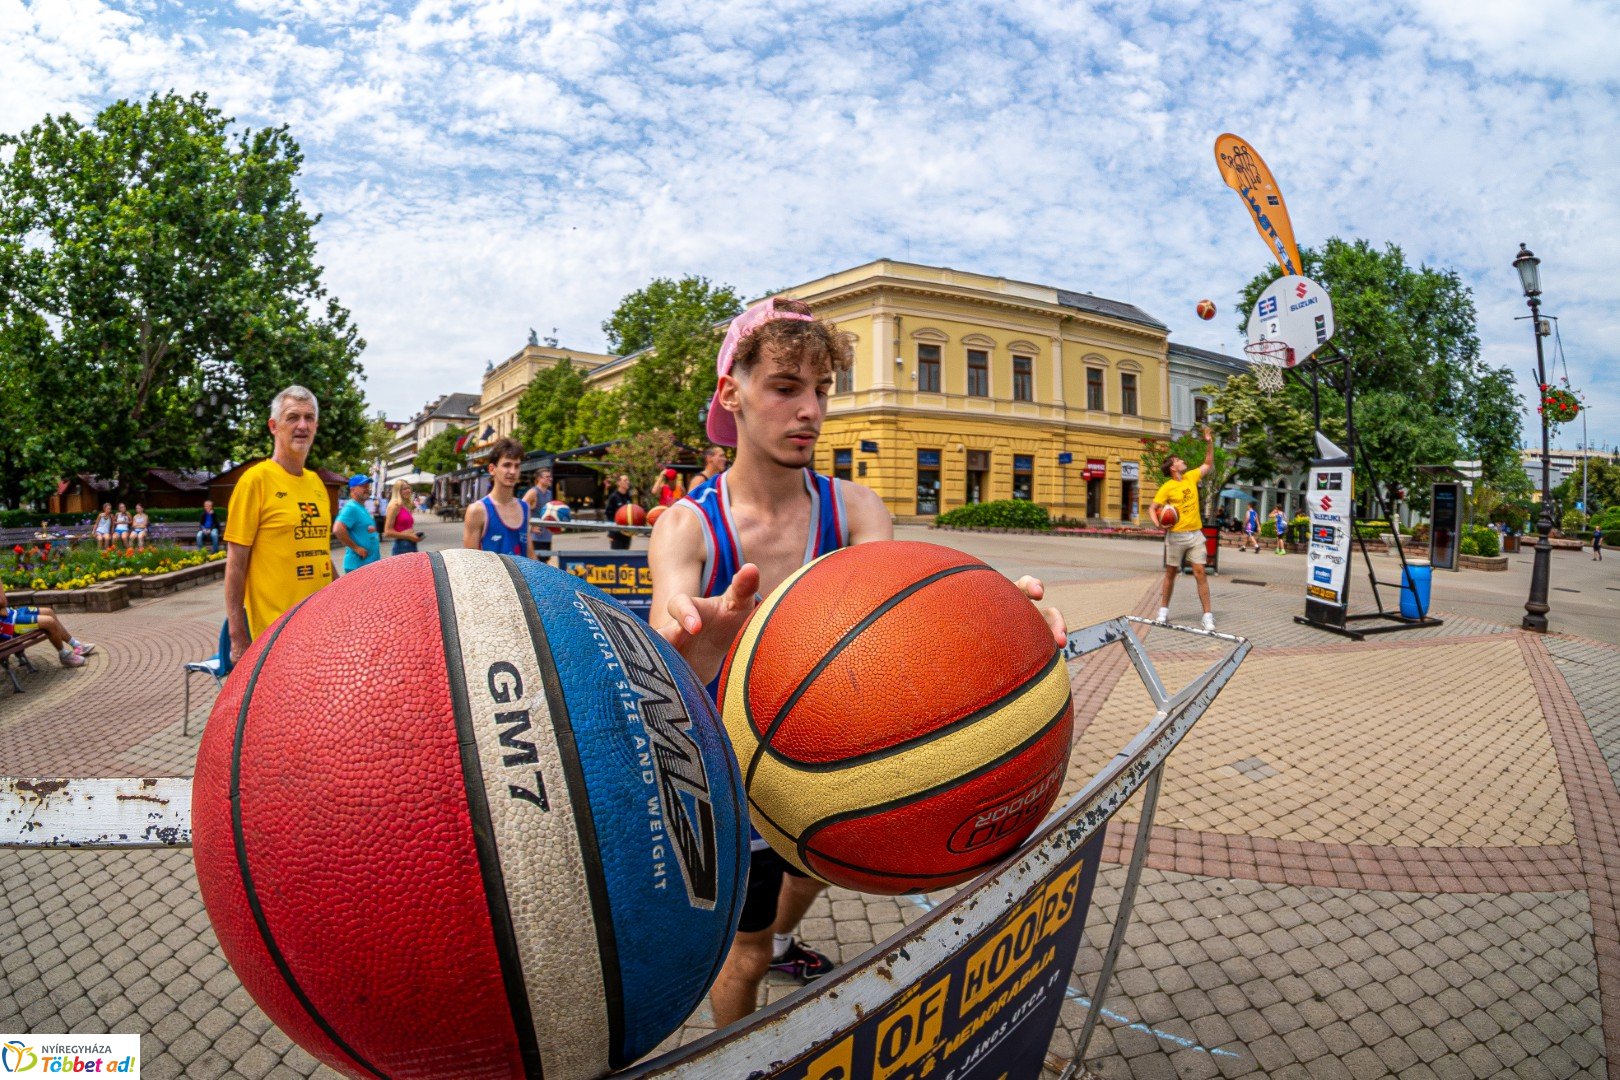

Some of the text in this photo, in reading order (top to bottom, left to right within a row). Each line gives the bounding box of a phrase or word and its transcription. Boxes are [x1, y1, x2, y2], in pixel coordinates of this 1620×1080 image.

[1270, 323, 1278, 334] 2
[1289, 296, 1319, 313] SUZUKI
[294, 525, 328, 540] STAFF
[1313, 513, 1341, 522] SUZUKI
[487, 660, 550, 813] GM7
[572, 600, 618, 671] OFFICIAL
[615, 681, 640, 724] SIZE
[633, 735, 655, 785] AND
[646, 796, 667, 891] WEIGHT
[878, 873, 1081, 1069] OF HOOPS
[942, 944, 1056, 1060] MEMORABILIA
[961, 1021, 1008, 1070] JÁNOS
[1012, 986, 1045, 1023] UTCA
